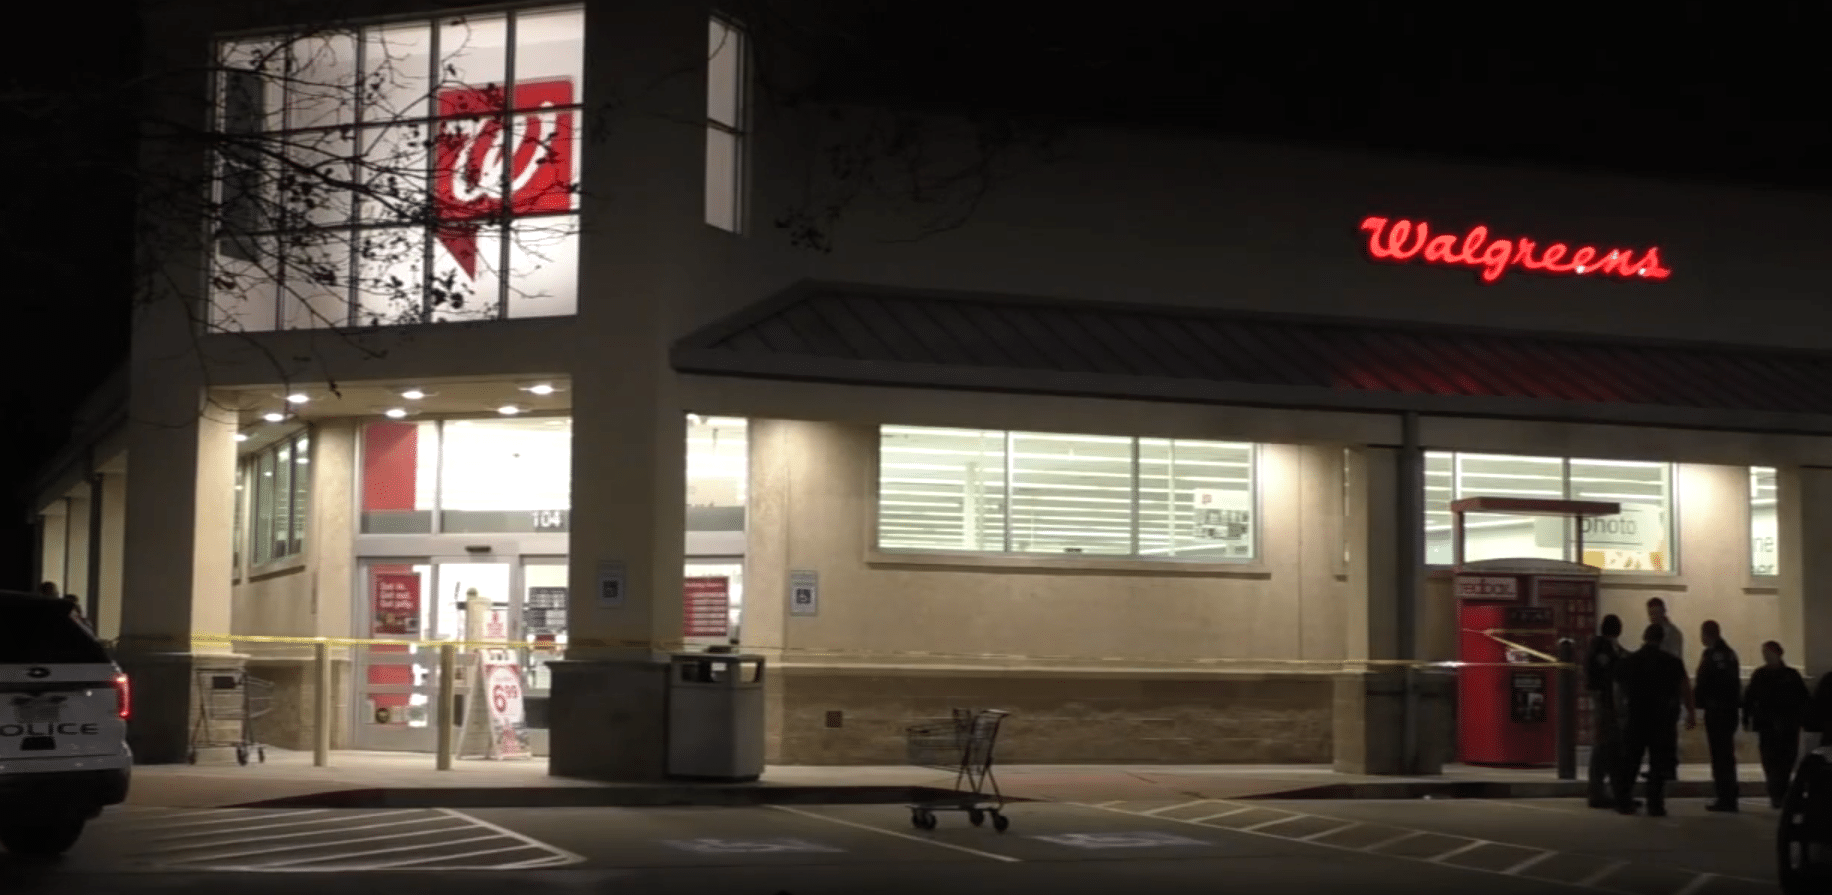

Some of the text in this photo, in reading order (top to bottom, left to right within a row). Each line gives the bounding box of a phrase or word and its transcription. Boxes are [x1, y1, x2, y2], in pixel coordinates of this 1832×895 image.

[1361, 216, 1671, 282] Walgreens
[533, 510, 560, 527] 104
[1583, 516, 1637, 535] photo
[0, 723, 100, 737] OLICE
